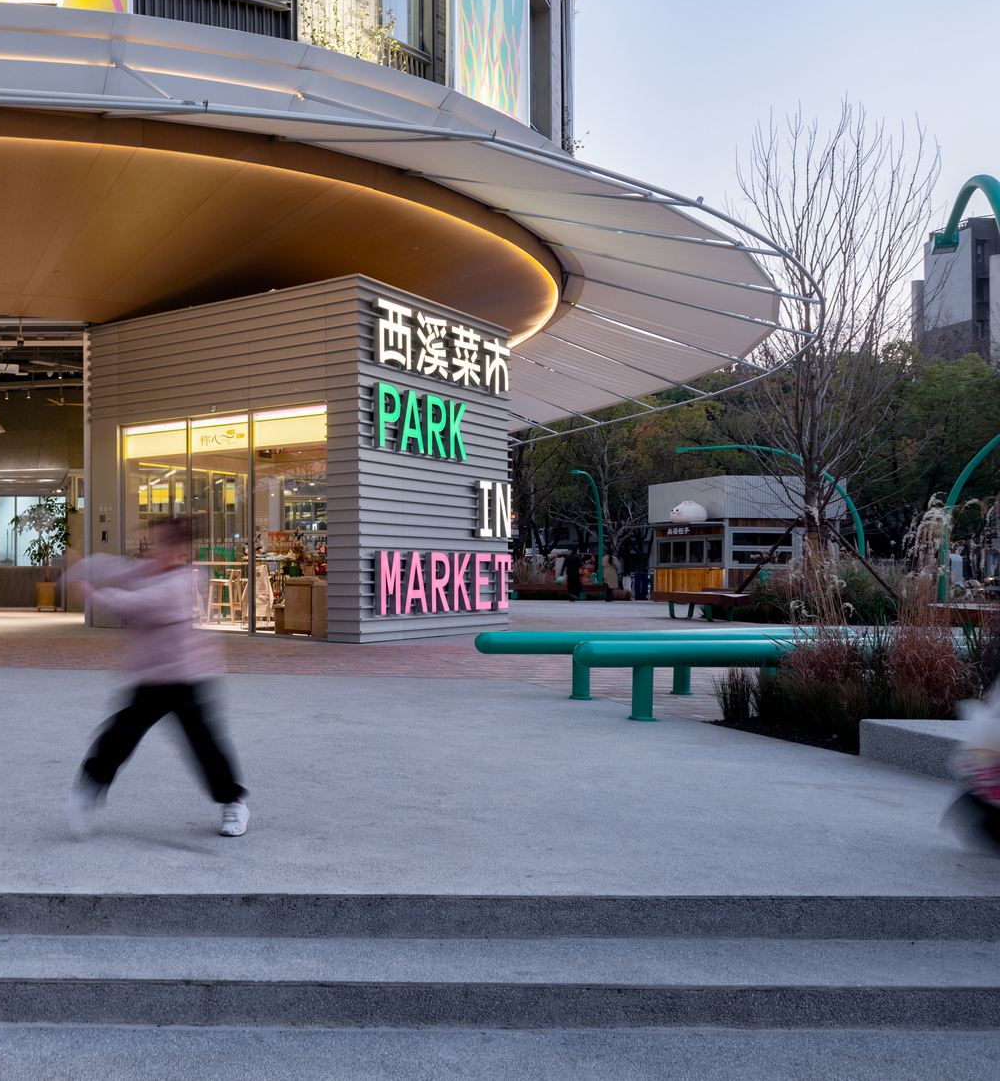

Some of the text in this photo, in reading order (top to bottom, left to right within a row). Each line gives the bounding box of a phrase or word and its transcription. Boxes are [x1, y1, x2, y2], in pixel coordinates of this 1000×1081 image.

[377, 297, 511, 396] 西溪菜市
[378, 381, 468, 461] PARK
[479, 480, 511, 538] IN
[380, 550, 513, 616] MARKET
